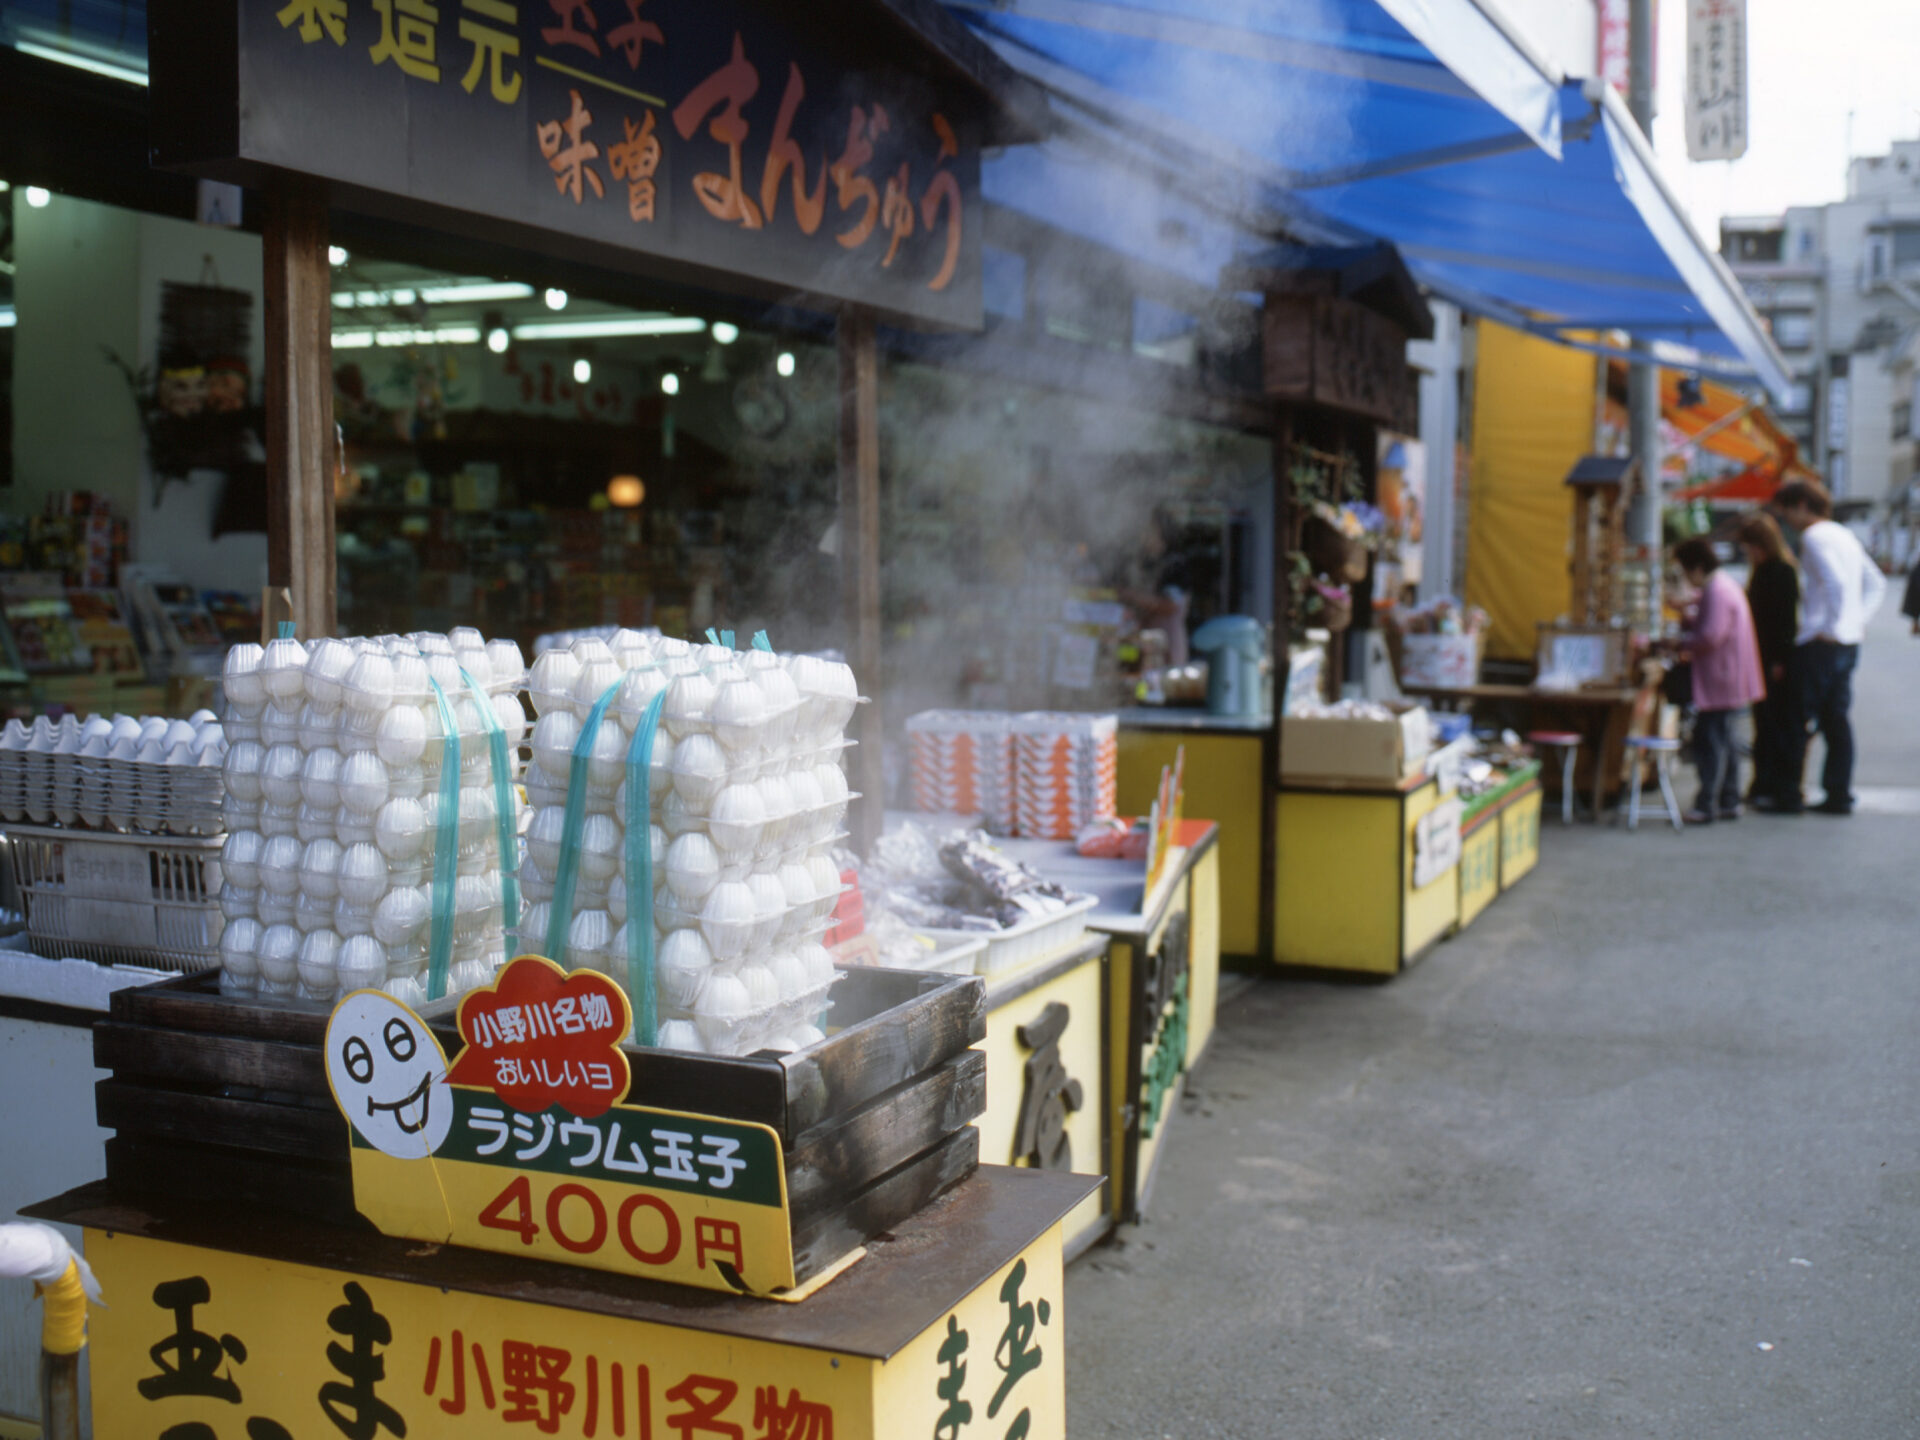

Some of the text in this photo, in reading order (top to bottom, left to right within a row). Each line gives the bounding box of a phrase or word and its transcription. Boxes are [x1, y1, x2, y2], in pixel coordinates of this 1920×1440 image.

[536, 89, 662, 222] 味噌
[473, 993, 612, 1048] 小野川名物
[495, 1057, 613, 1090] おいしいヨ
[468, 1107, 746, 1188] ラジウム玉子
[478, 1175, 743, 1275] 400円
[424, 1329, 834, 1440] 小野川名物
